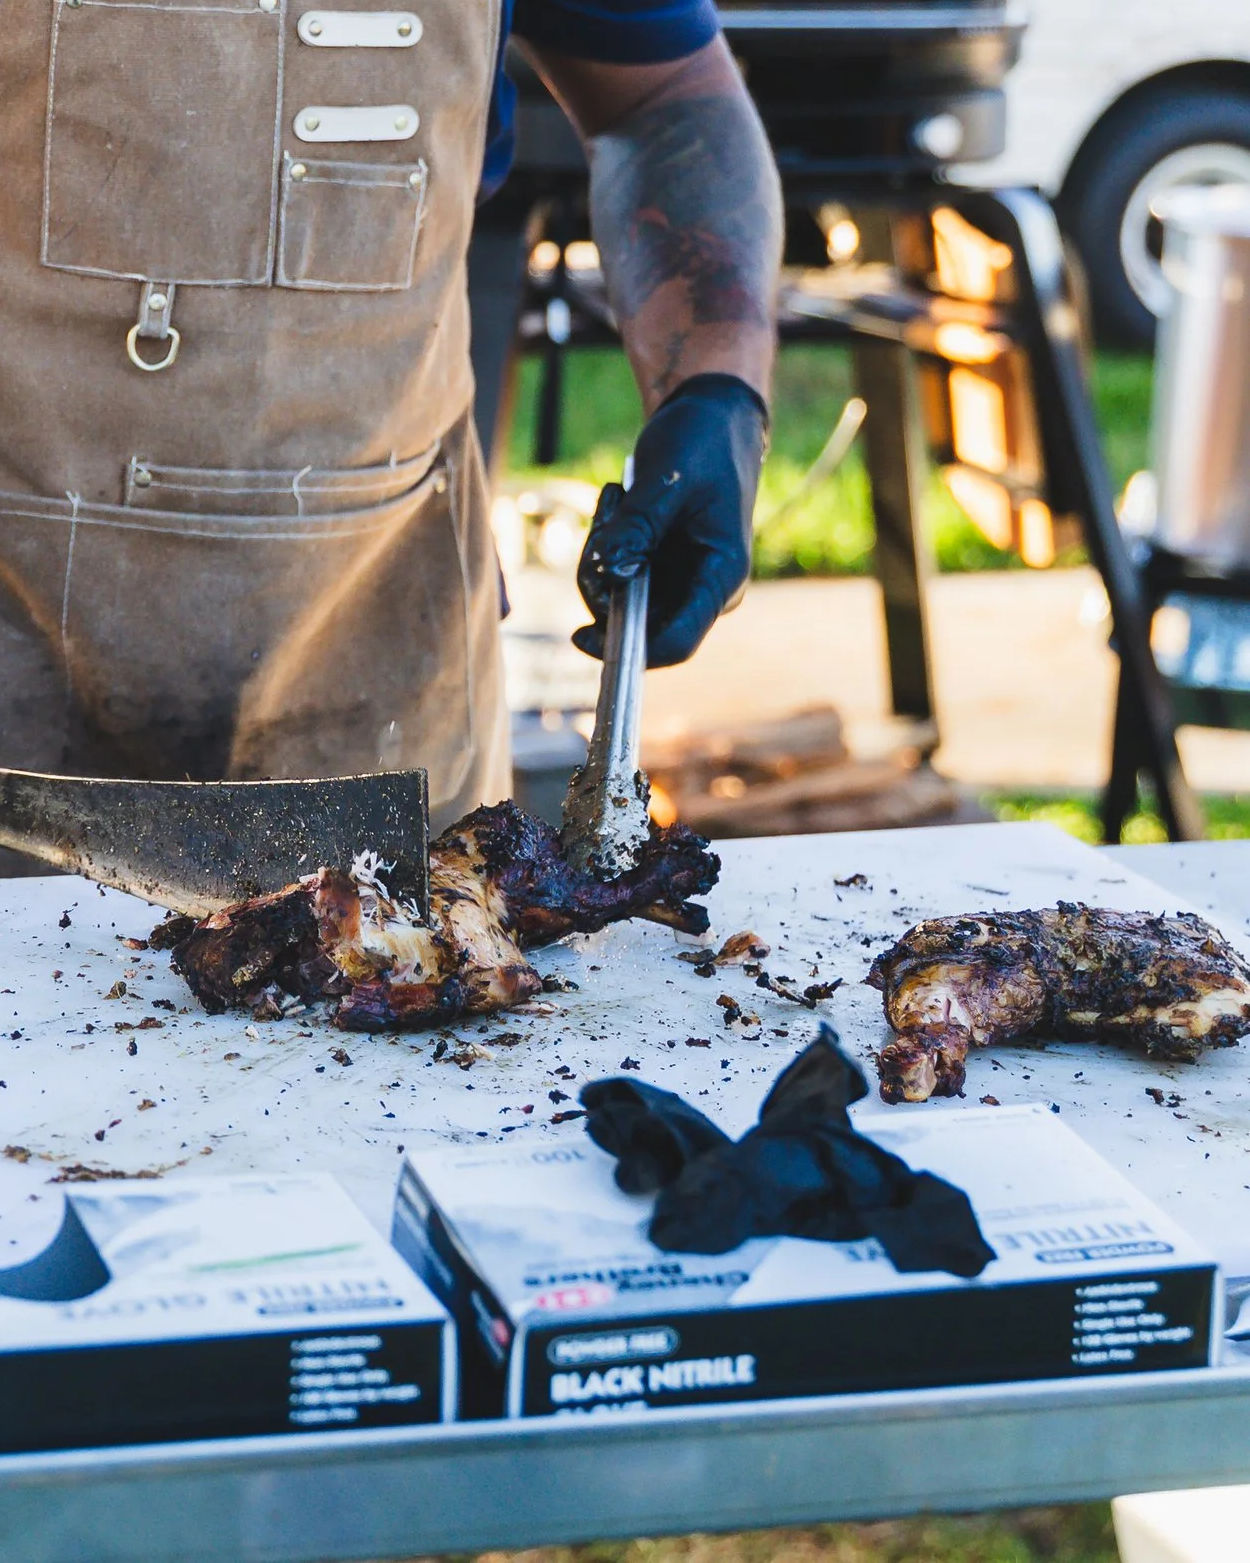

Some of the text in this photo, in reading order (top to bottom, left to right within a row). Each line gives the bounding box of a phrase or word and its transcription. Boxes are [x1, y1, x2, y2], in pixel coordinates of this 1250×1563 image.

[993, 1220, 1155, 1250] NITRILE
[551, 1354, 756, 1403] BLACK NITRILE
